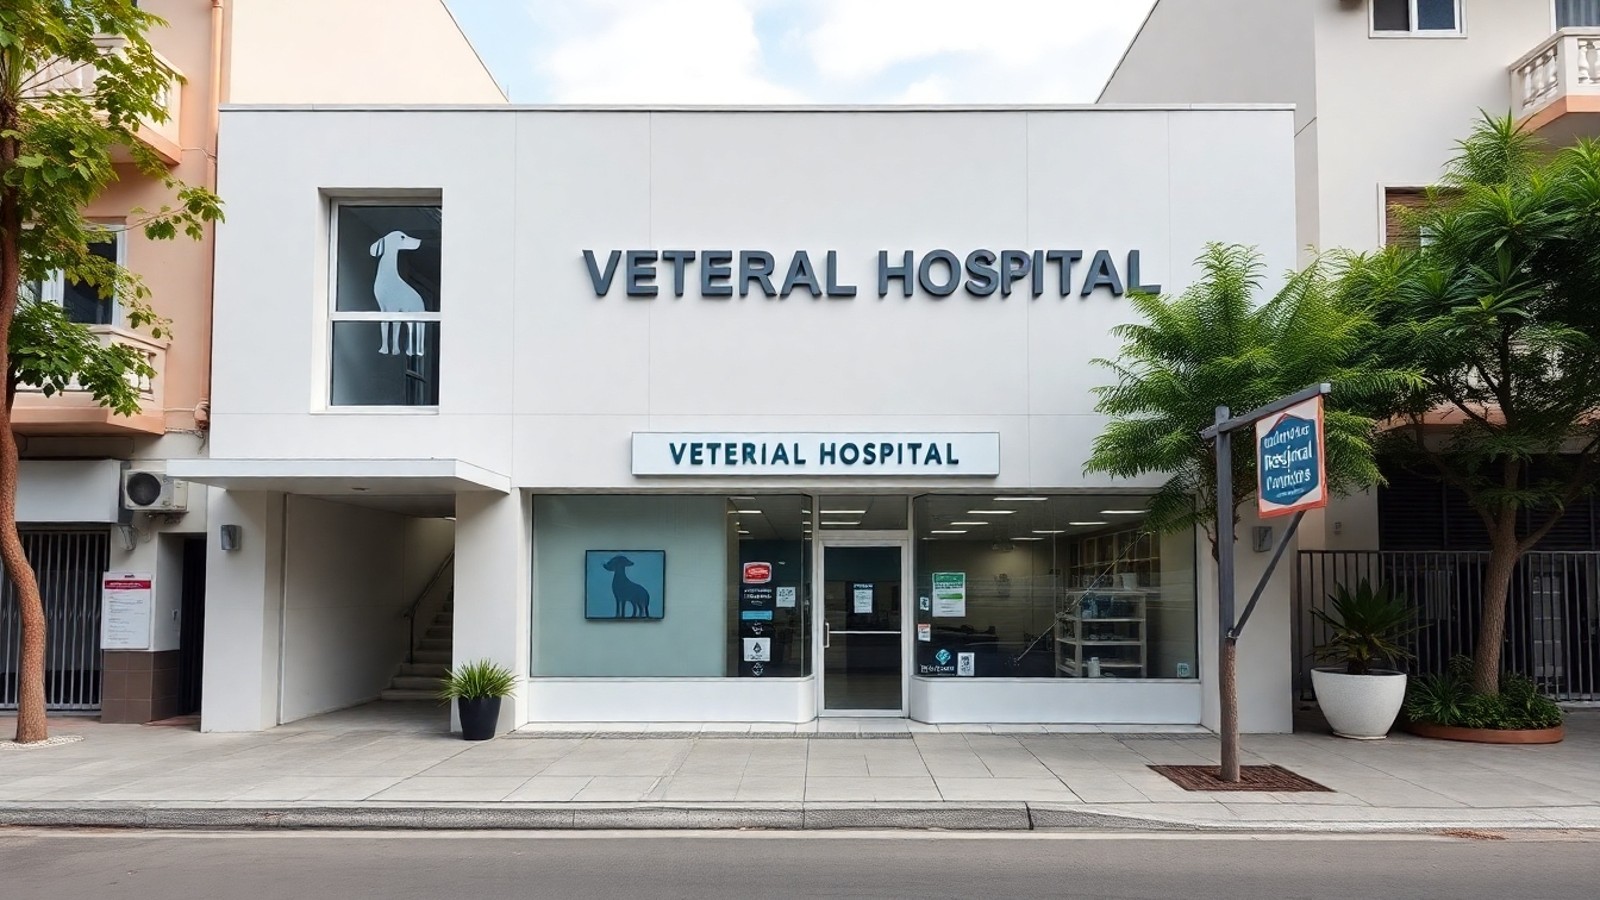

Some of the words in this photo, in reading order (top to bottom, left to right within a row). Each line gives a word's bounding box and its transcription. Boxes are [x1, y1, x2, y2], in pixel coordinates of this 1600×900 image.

[582, 249, 856, 298] VETERAL
[878, 249, 1161, 298] HOSPITAL
[669, 442, 806, 465] VETERIAL
[819, 442, 960, 465] HOSPITAL
